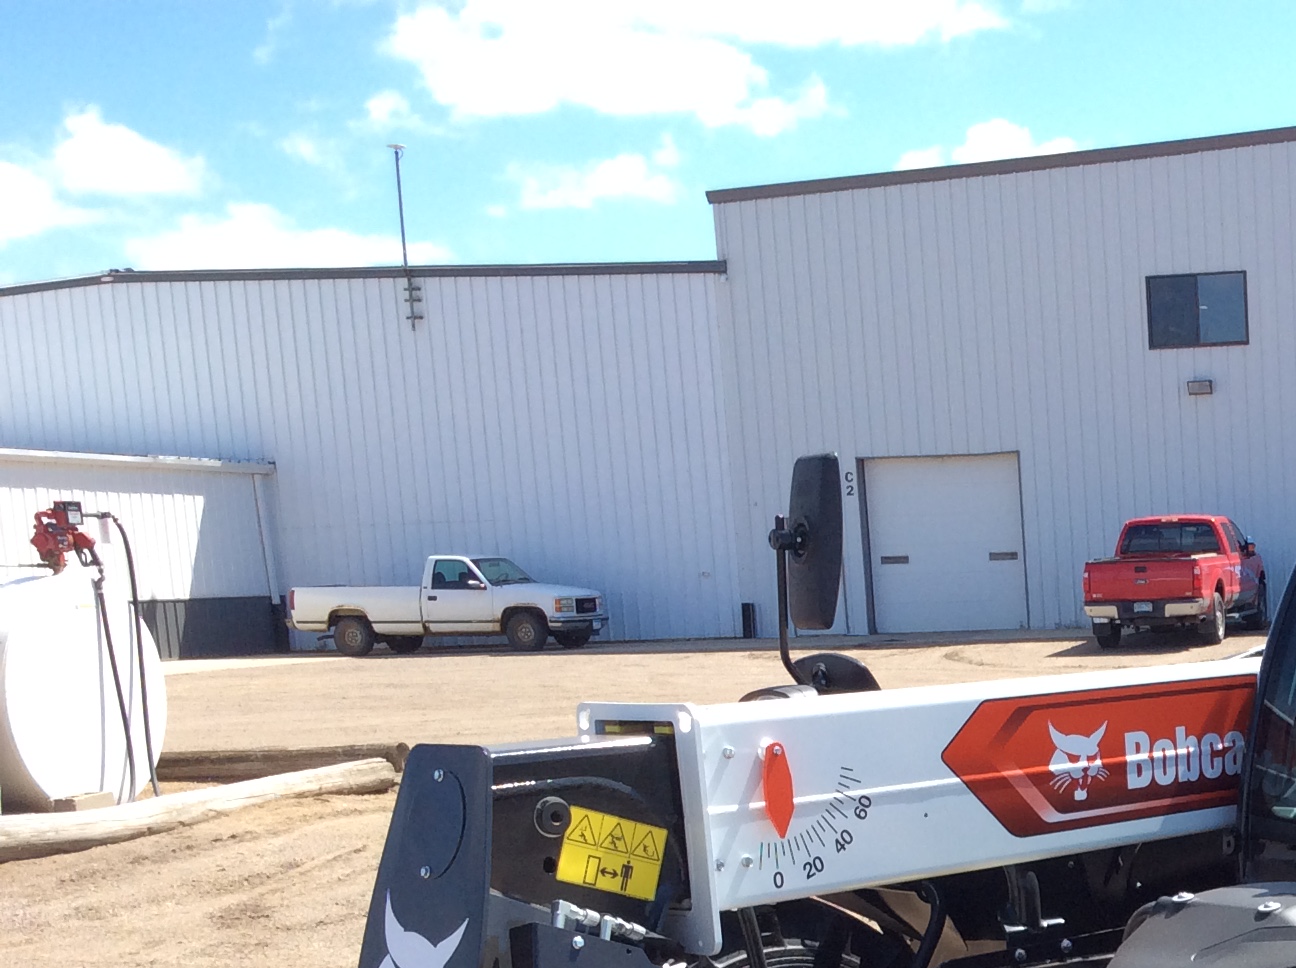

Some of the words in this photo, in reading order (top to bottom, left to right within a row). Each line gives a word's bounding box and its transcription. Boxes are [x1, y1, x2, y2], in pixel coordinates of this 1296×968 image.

[1124, 725, 1245, 790] Bobca
[773, 871, 785, 889] 0
[802, 856, 825, 880] 20
[834, 829, 854, 853] 40
[854, 795, 872, 820] 60
